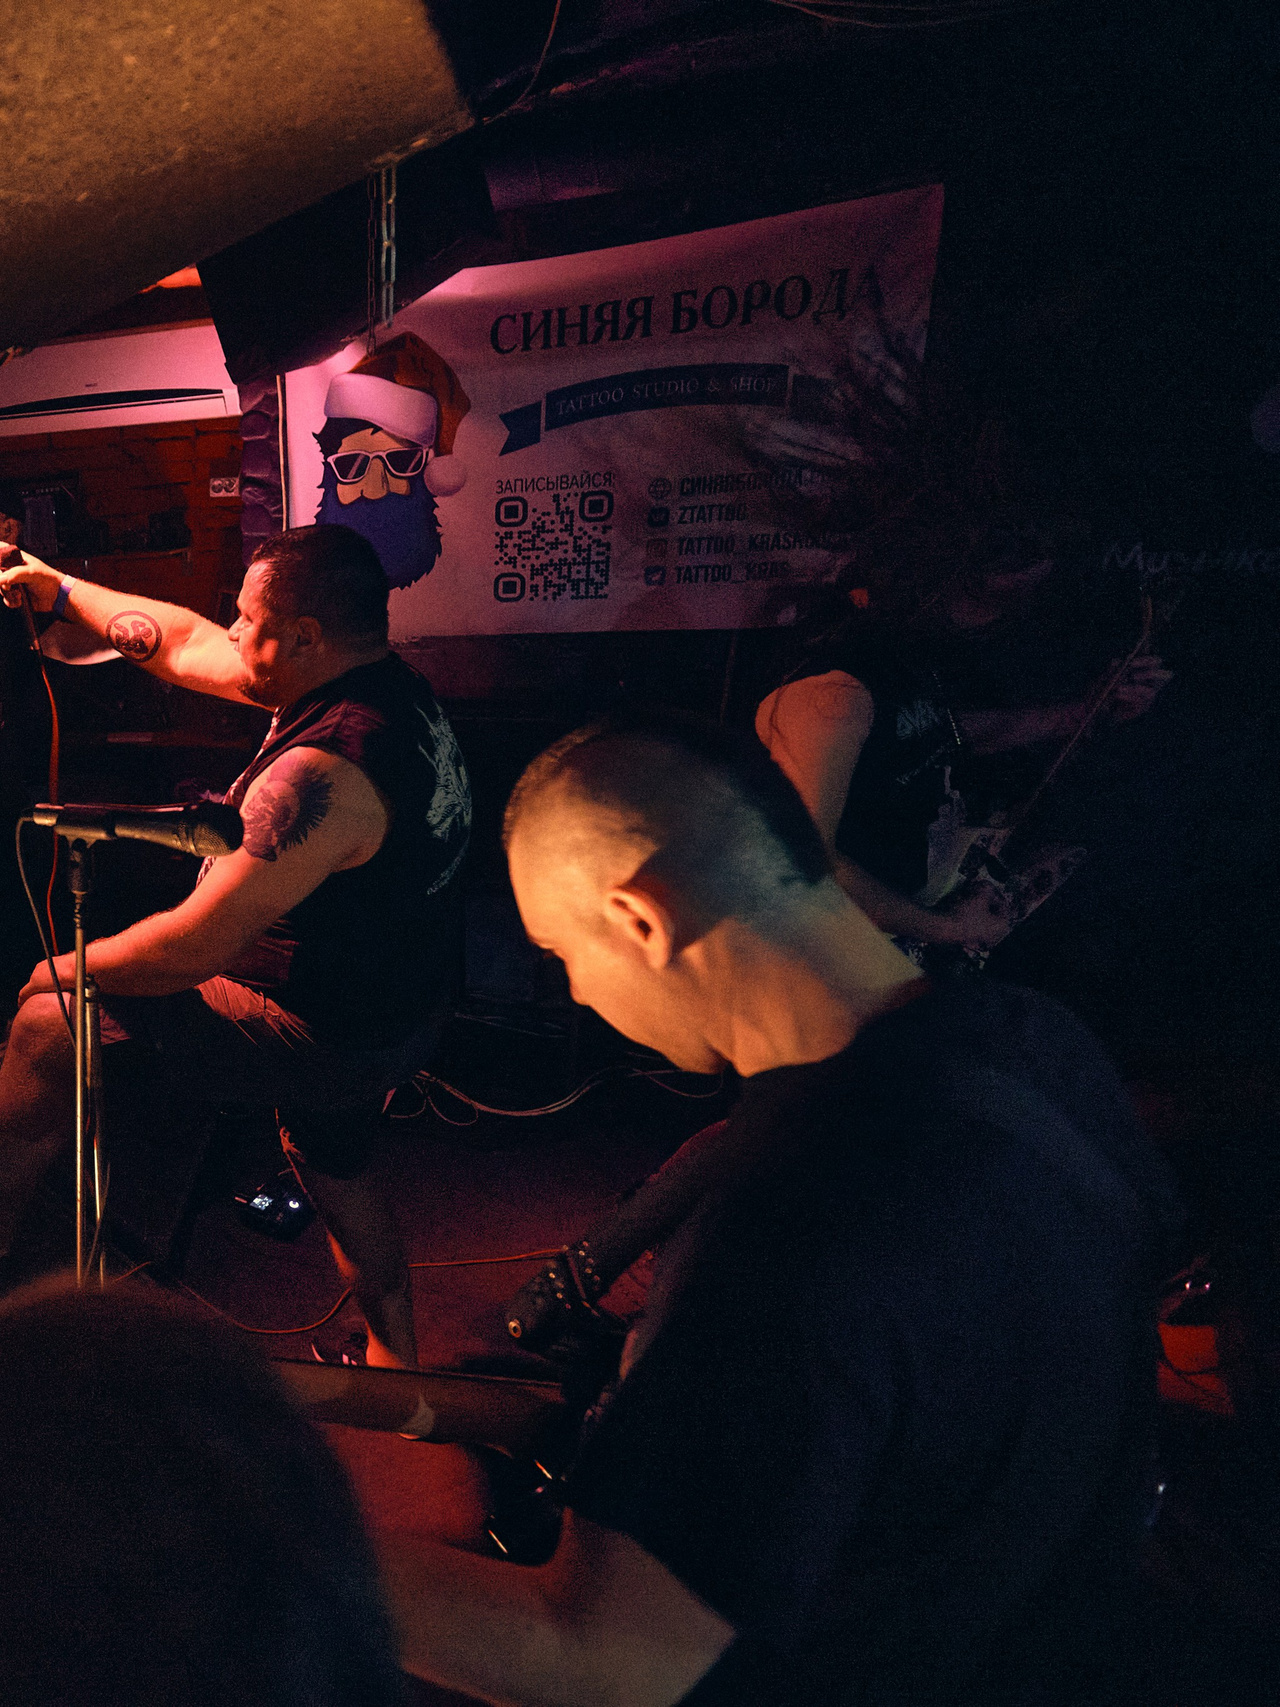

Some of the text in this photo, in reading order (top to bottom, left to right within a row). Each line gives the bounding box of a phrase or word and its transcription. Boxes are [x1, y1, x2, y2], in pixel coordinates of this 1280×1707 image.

[489, 264, 884, 355] СИНЯЯ БОРОДА
[556, 375, 777, 416] TATTOO STUDIO & SHOP
